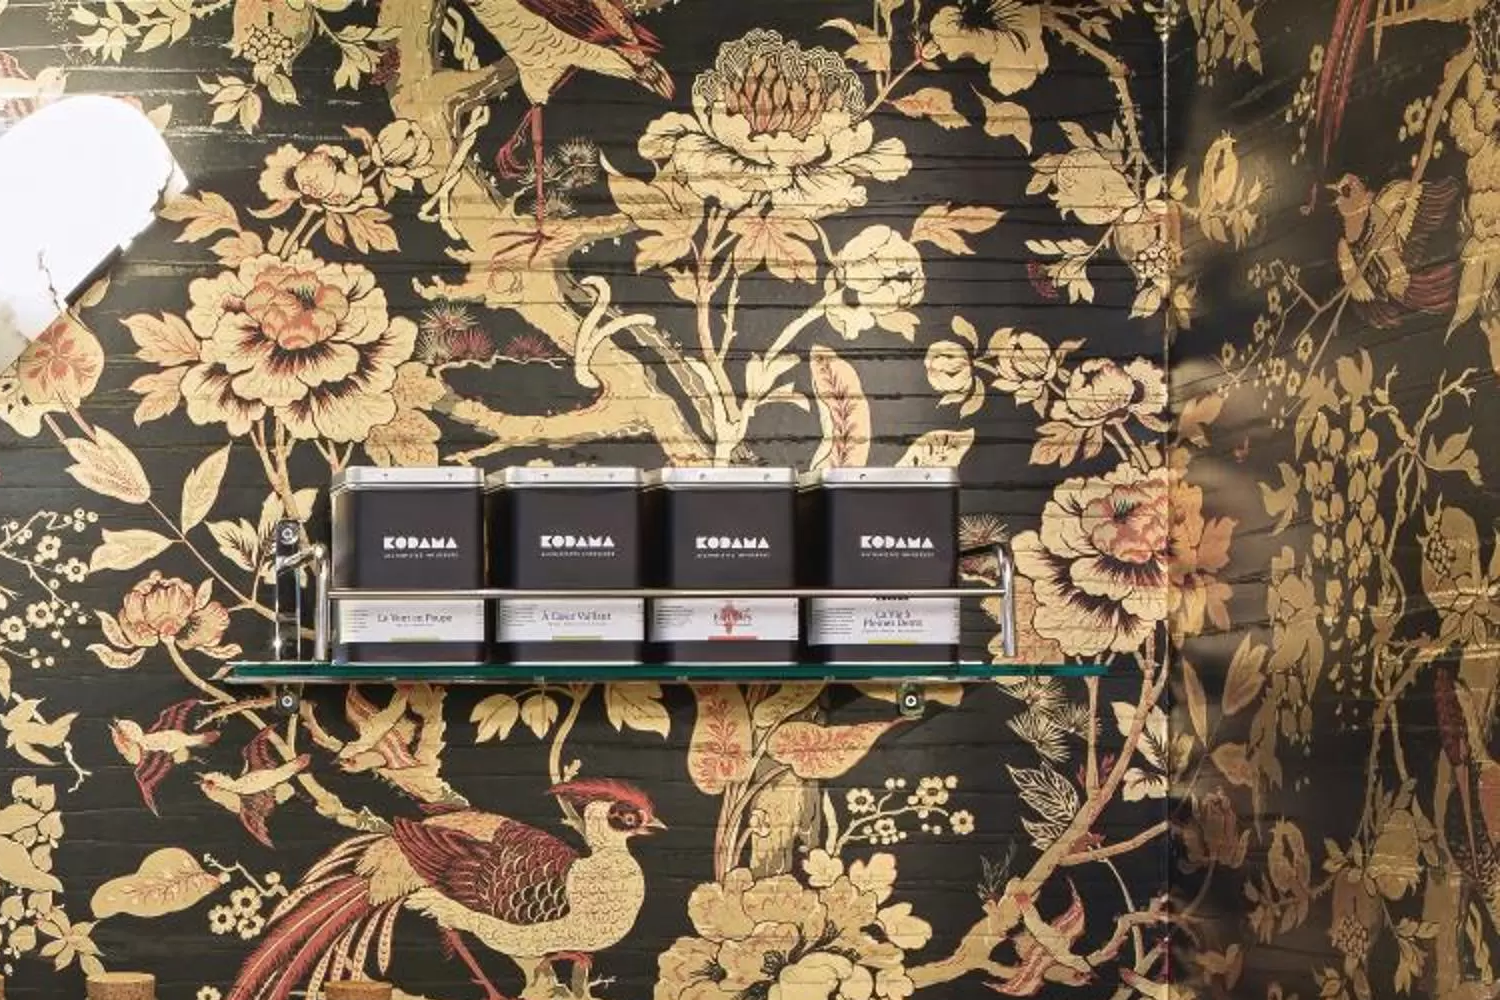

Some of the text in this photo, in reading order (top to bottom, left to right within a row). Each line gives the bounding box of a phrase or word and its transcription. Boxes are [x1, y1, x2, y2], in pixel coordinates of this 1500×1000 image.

[383, 536, 458, 549] KODAMA
[541, 535, 615, 548] KODAMA
[695, 536, 770, 549] KODAMA
[860, 535, 934, 549] KODAMA
